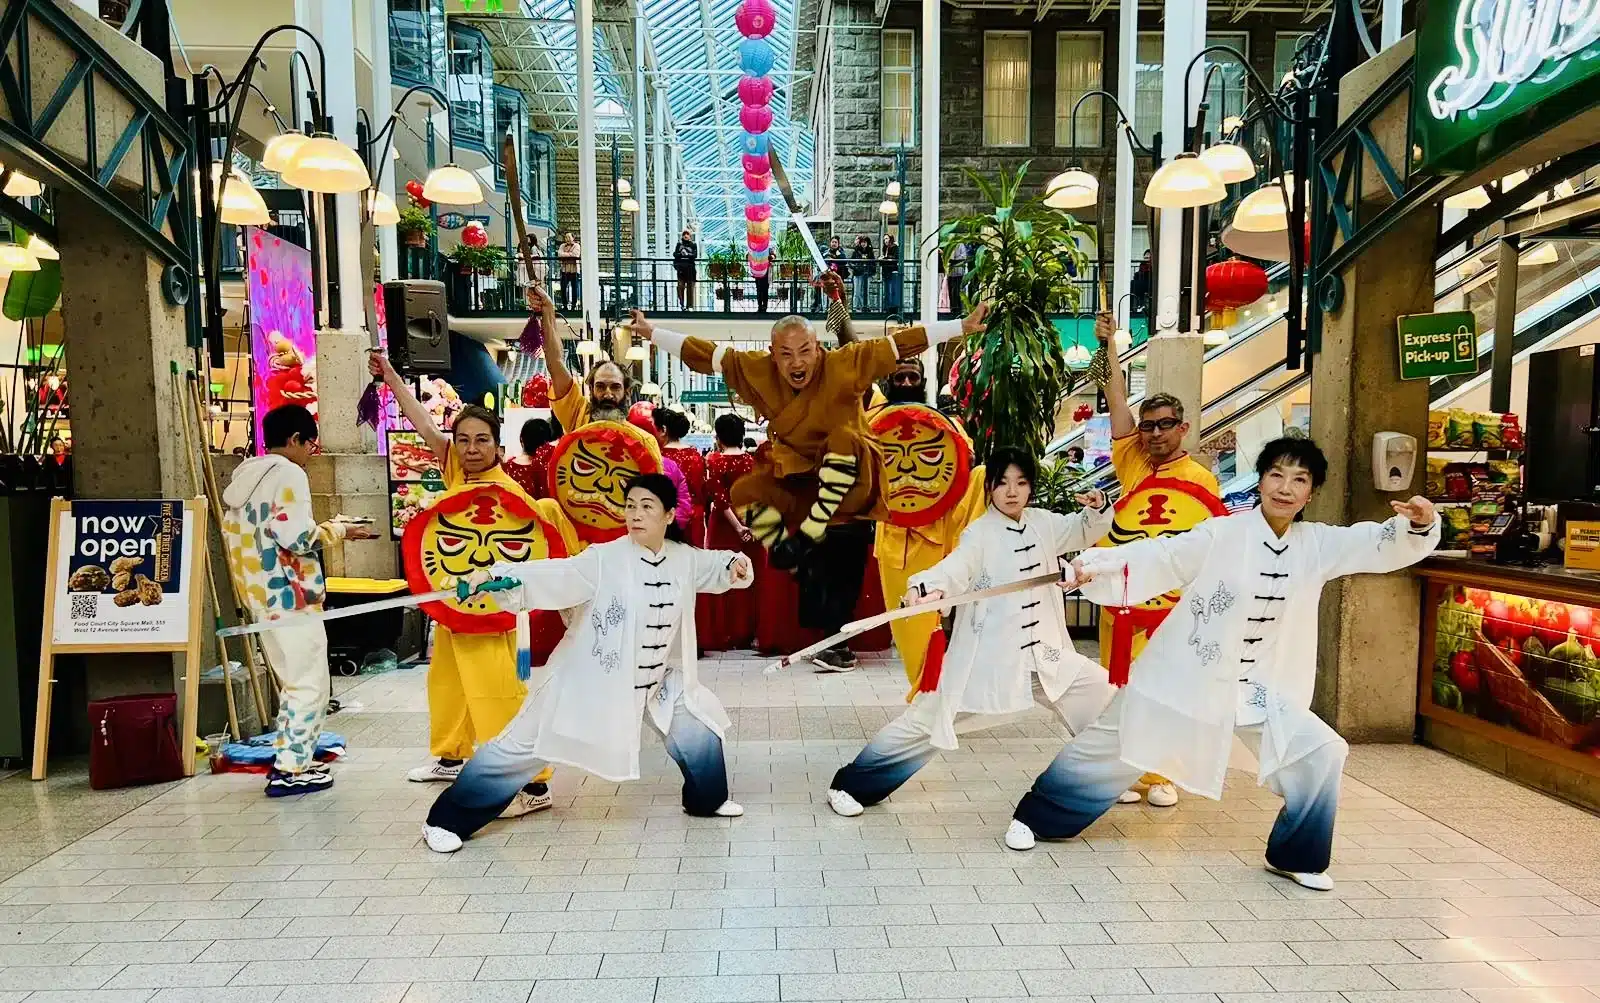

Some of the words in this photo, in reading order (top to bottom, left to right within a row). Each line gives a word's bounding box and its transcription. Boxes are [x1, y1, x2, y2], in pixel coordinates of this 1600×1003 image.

[1404, 333, 1451, 347] Express
[1405, 350, 1450, 363] Pick-up
[82, 516, 146, 534] now
[162, 518, 171, 533] STAR
[80, 538, 157, 562] open
[161, 534, 171, 552] FRIED
[160, 553, 170, 581] CHICKEN
